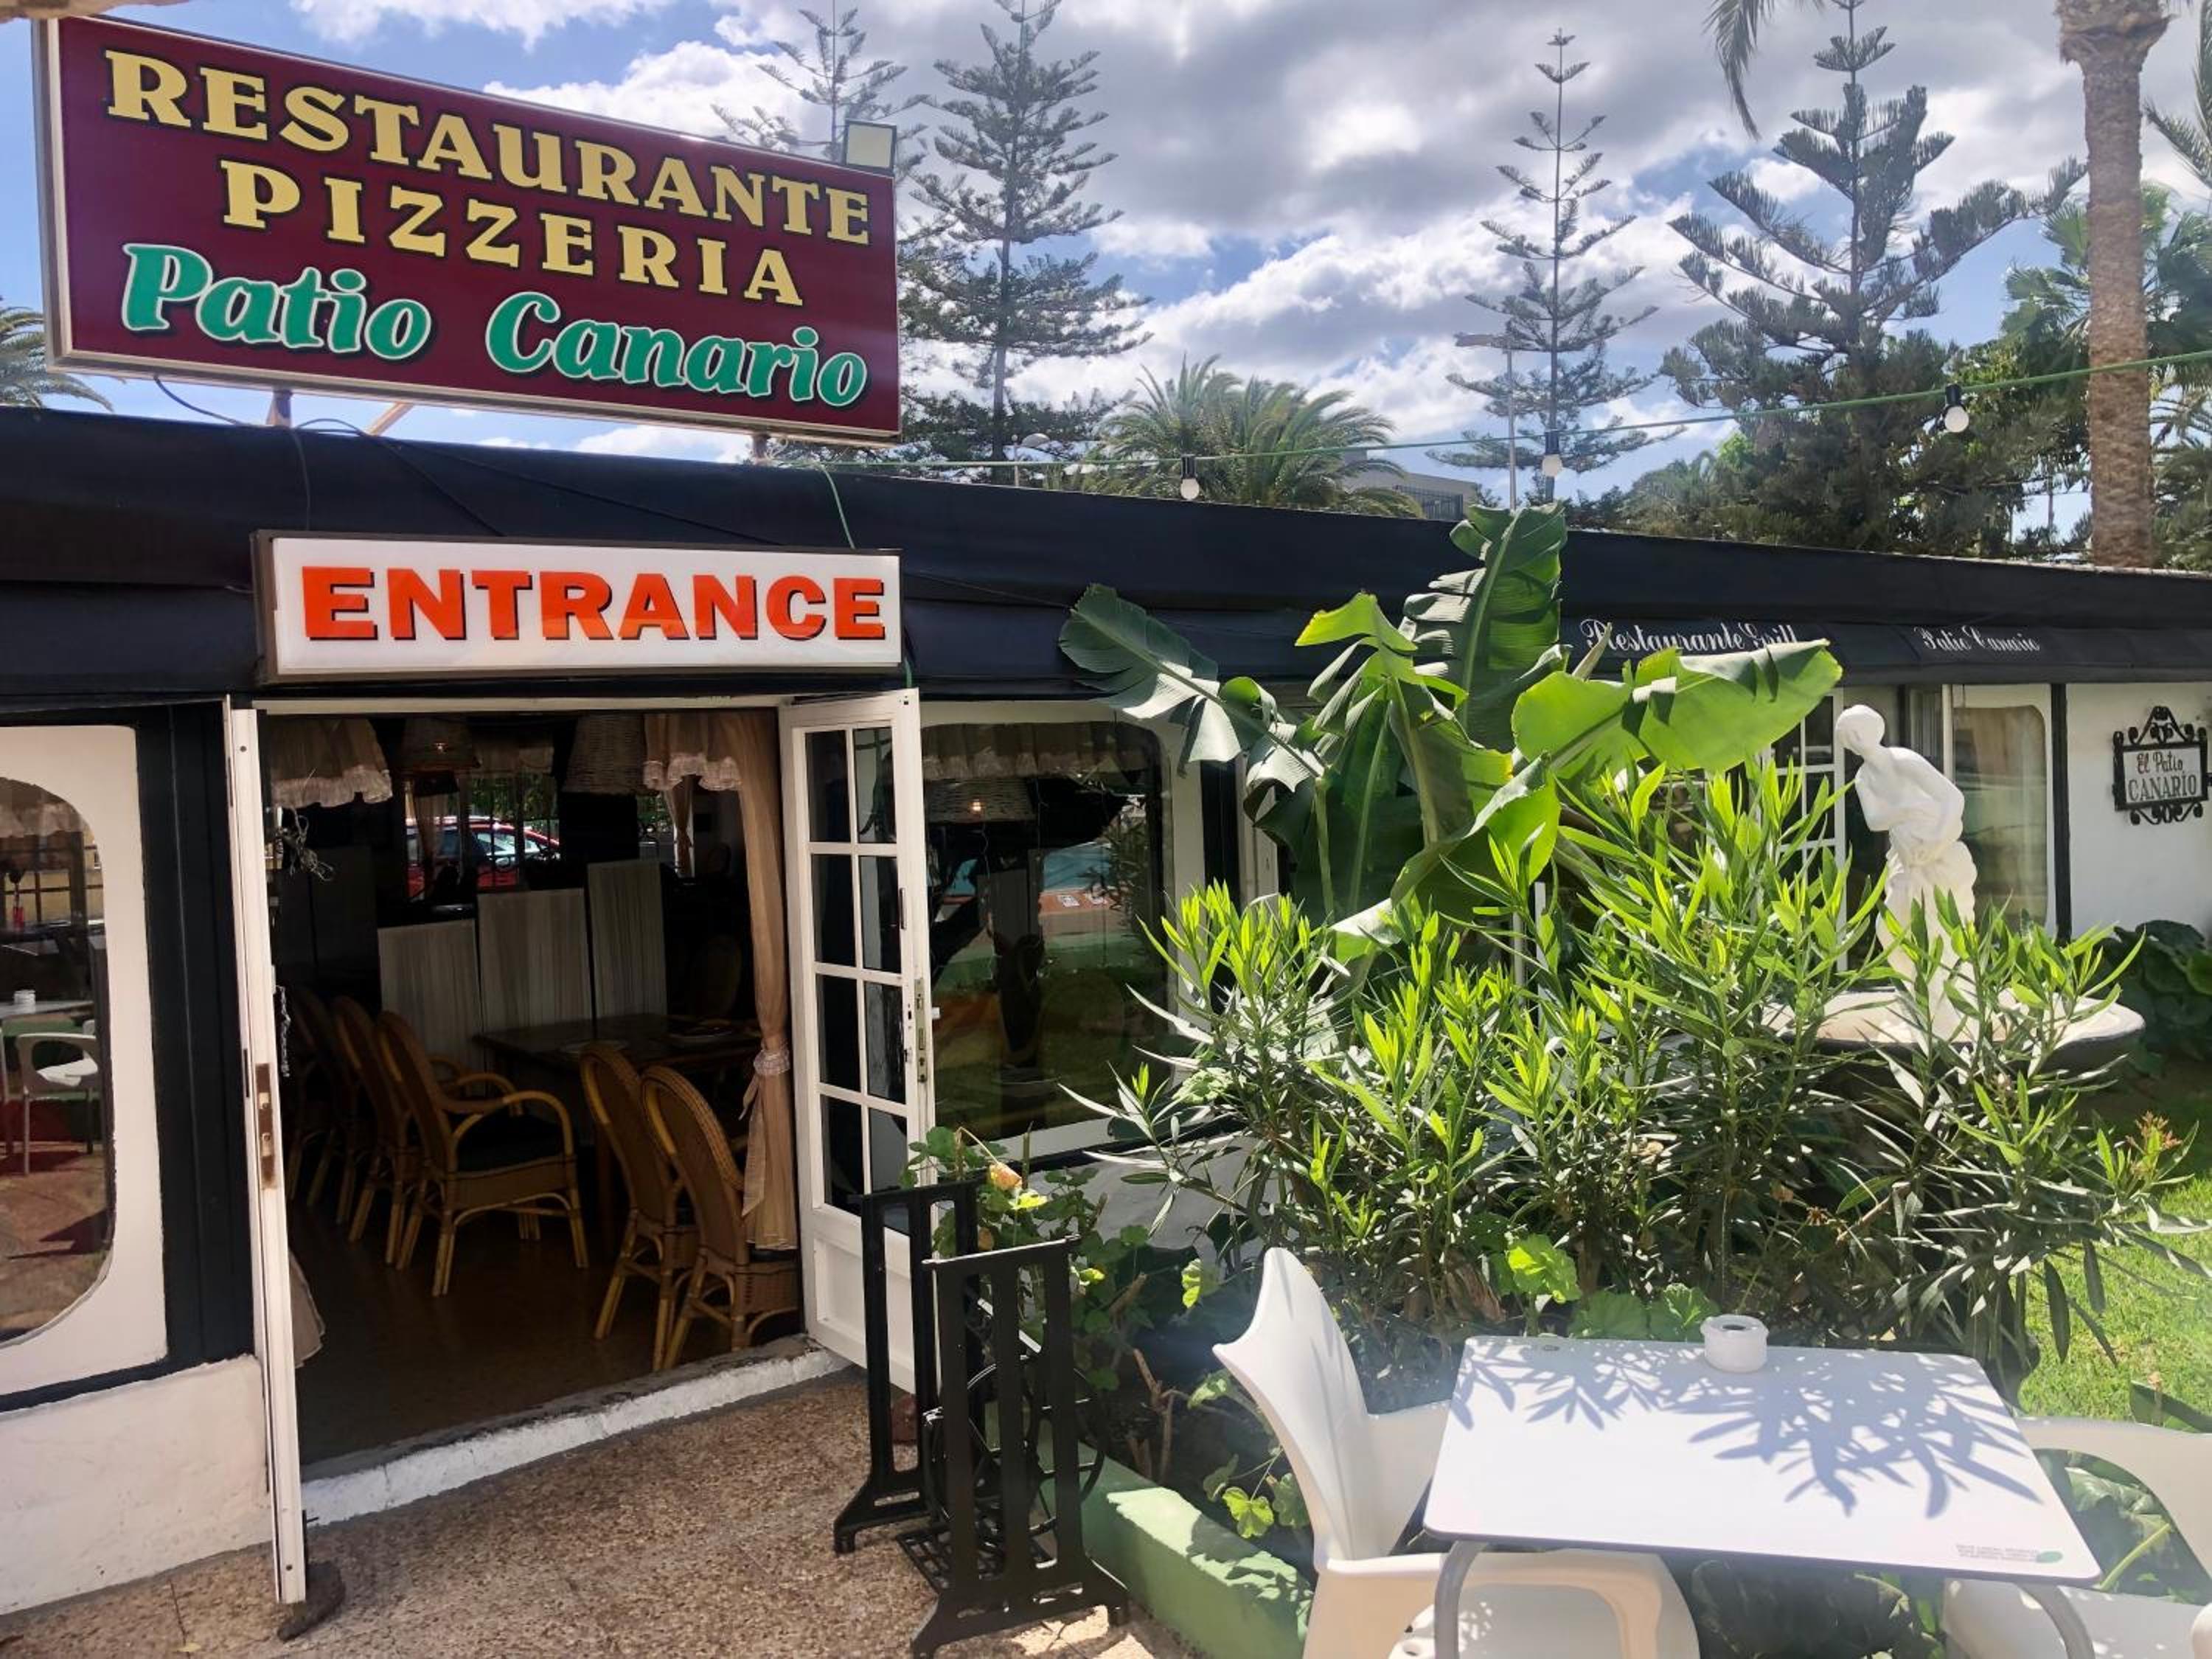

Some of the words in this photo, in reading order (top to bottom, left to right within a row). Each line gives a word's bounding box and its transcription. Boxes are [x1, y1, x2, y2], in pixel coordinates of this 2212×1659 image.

[105, 49, 872, 246] RESTAURANTE
[220, 159, 804, 306] PIZZERIA
[121, 242, 432, 362] Patio
[484, 291, 869, 409] Canario
[301, 566, 886, 641] ENTRANCE
[2128, 773, 2197, 801] CANARIO
[2137, 752, 2150, 774] El
[2152, 751, 2183, 773] Patio
